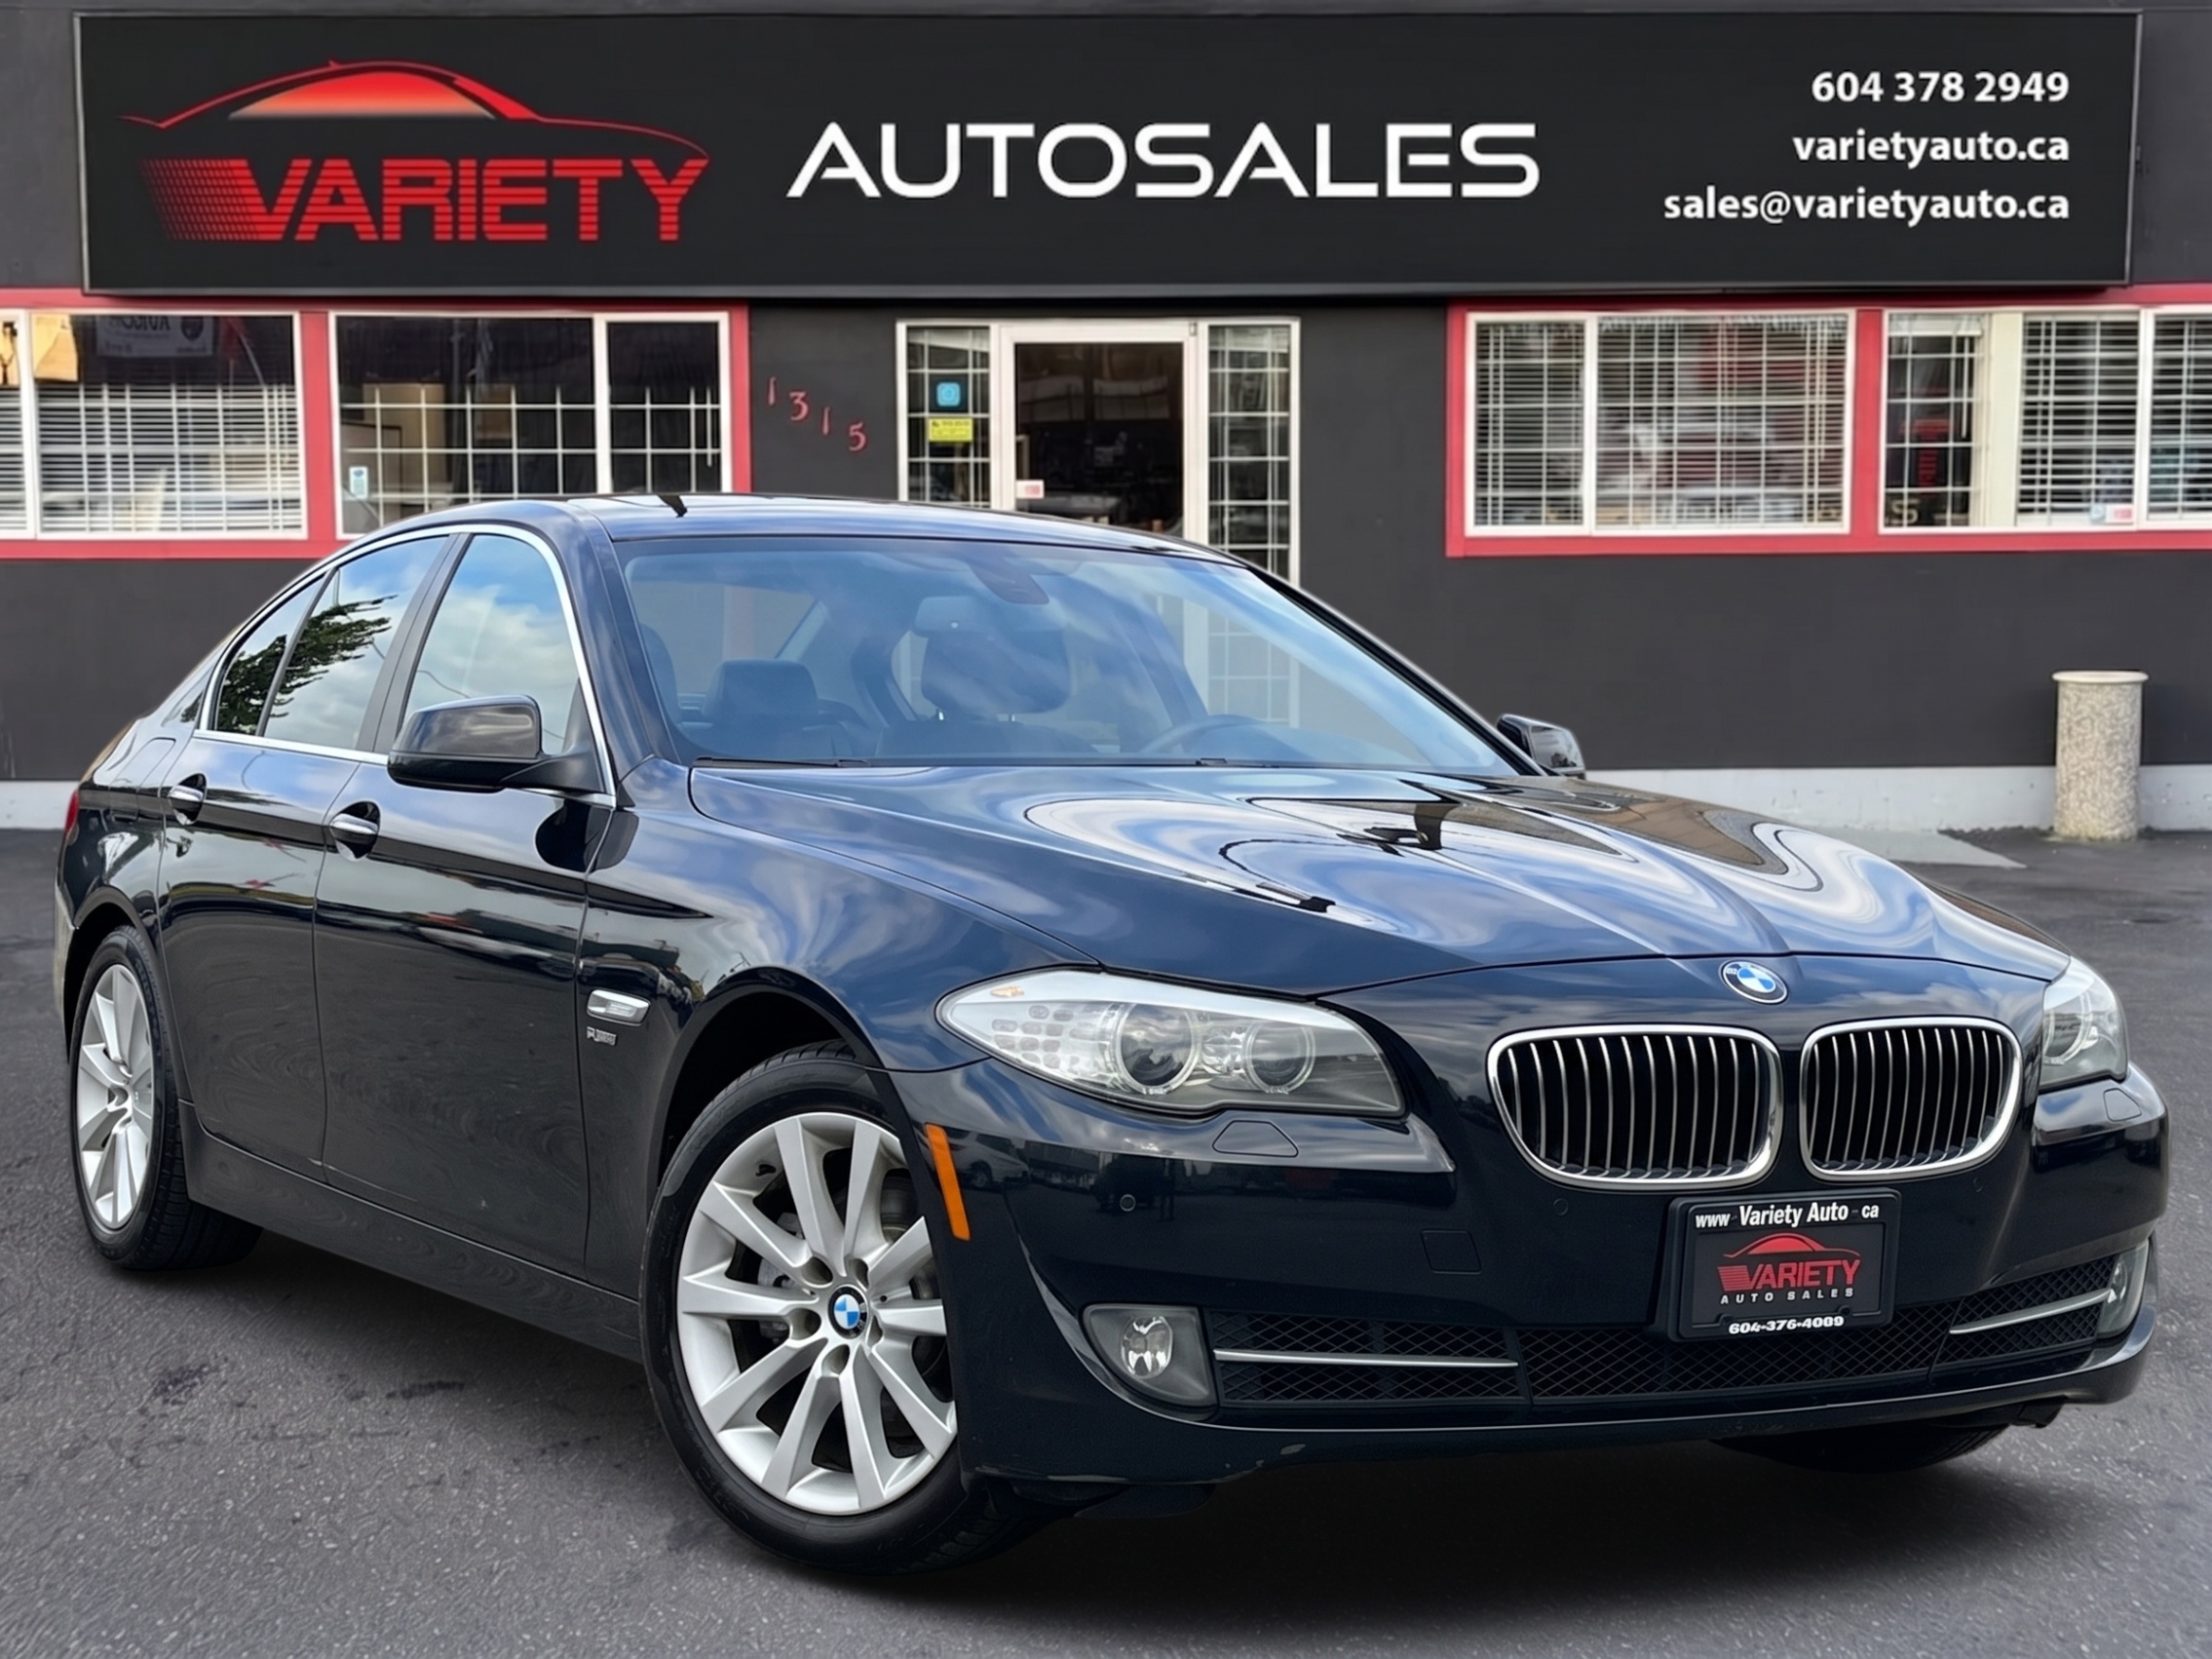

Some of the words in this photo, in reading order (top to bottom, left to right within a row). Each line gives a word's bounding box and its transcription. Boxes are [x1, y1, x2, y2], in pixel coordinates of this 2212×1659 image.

[1812, 71, 1885, 102] 604
[1893, 71, 1964, 102] 378
[1974, 71, 2070, 102] 2949
[785, 121, 1541, 199] AUTOSALES
[1792, 128, 2070, 170] varietyauto.ca
[146, 159, 709, 241] VARIETY
[1663, 184, 2070, 228] sales@varietyauto.ca
[1739, 1204, 1804, 1228] Variety
[1806, 1201, 1850, 1223] Auto
[1718, 1258, 1860, 1292] VARIETY
[1720, 1292, 1773, 1304] AUTO
[1787, 1288, 1853, 1300] SALES
